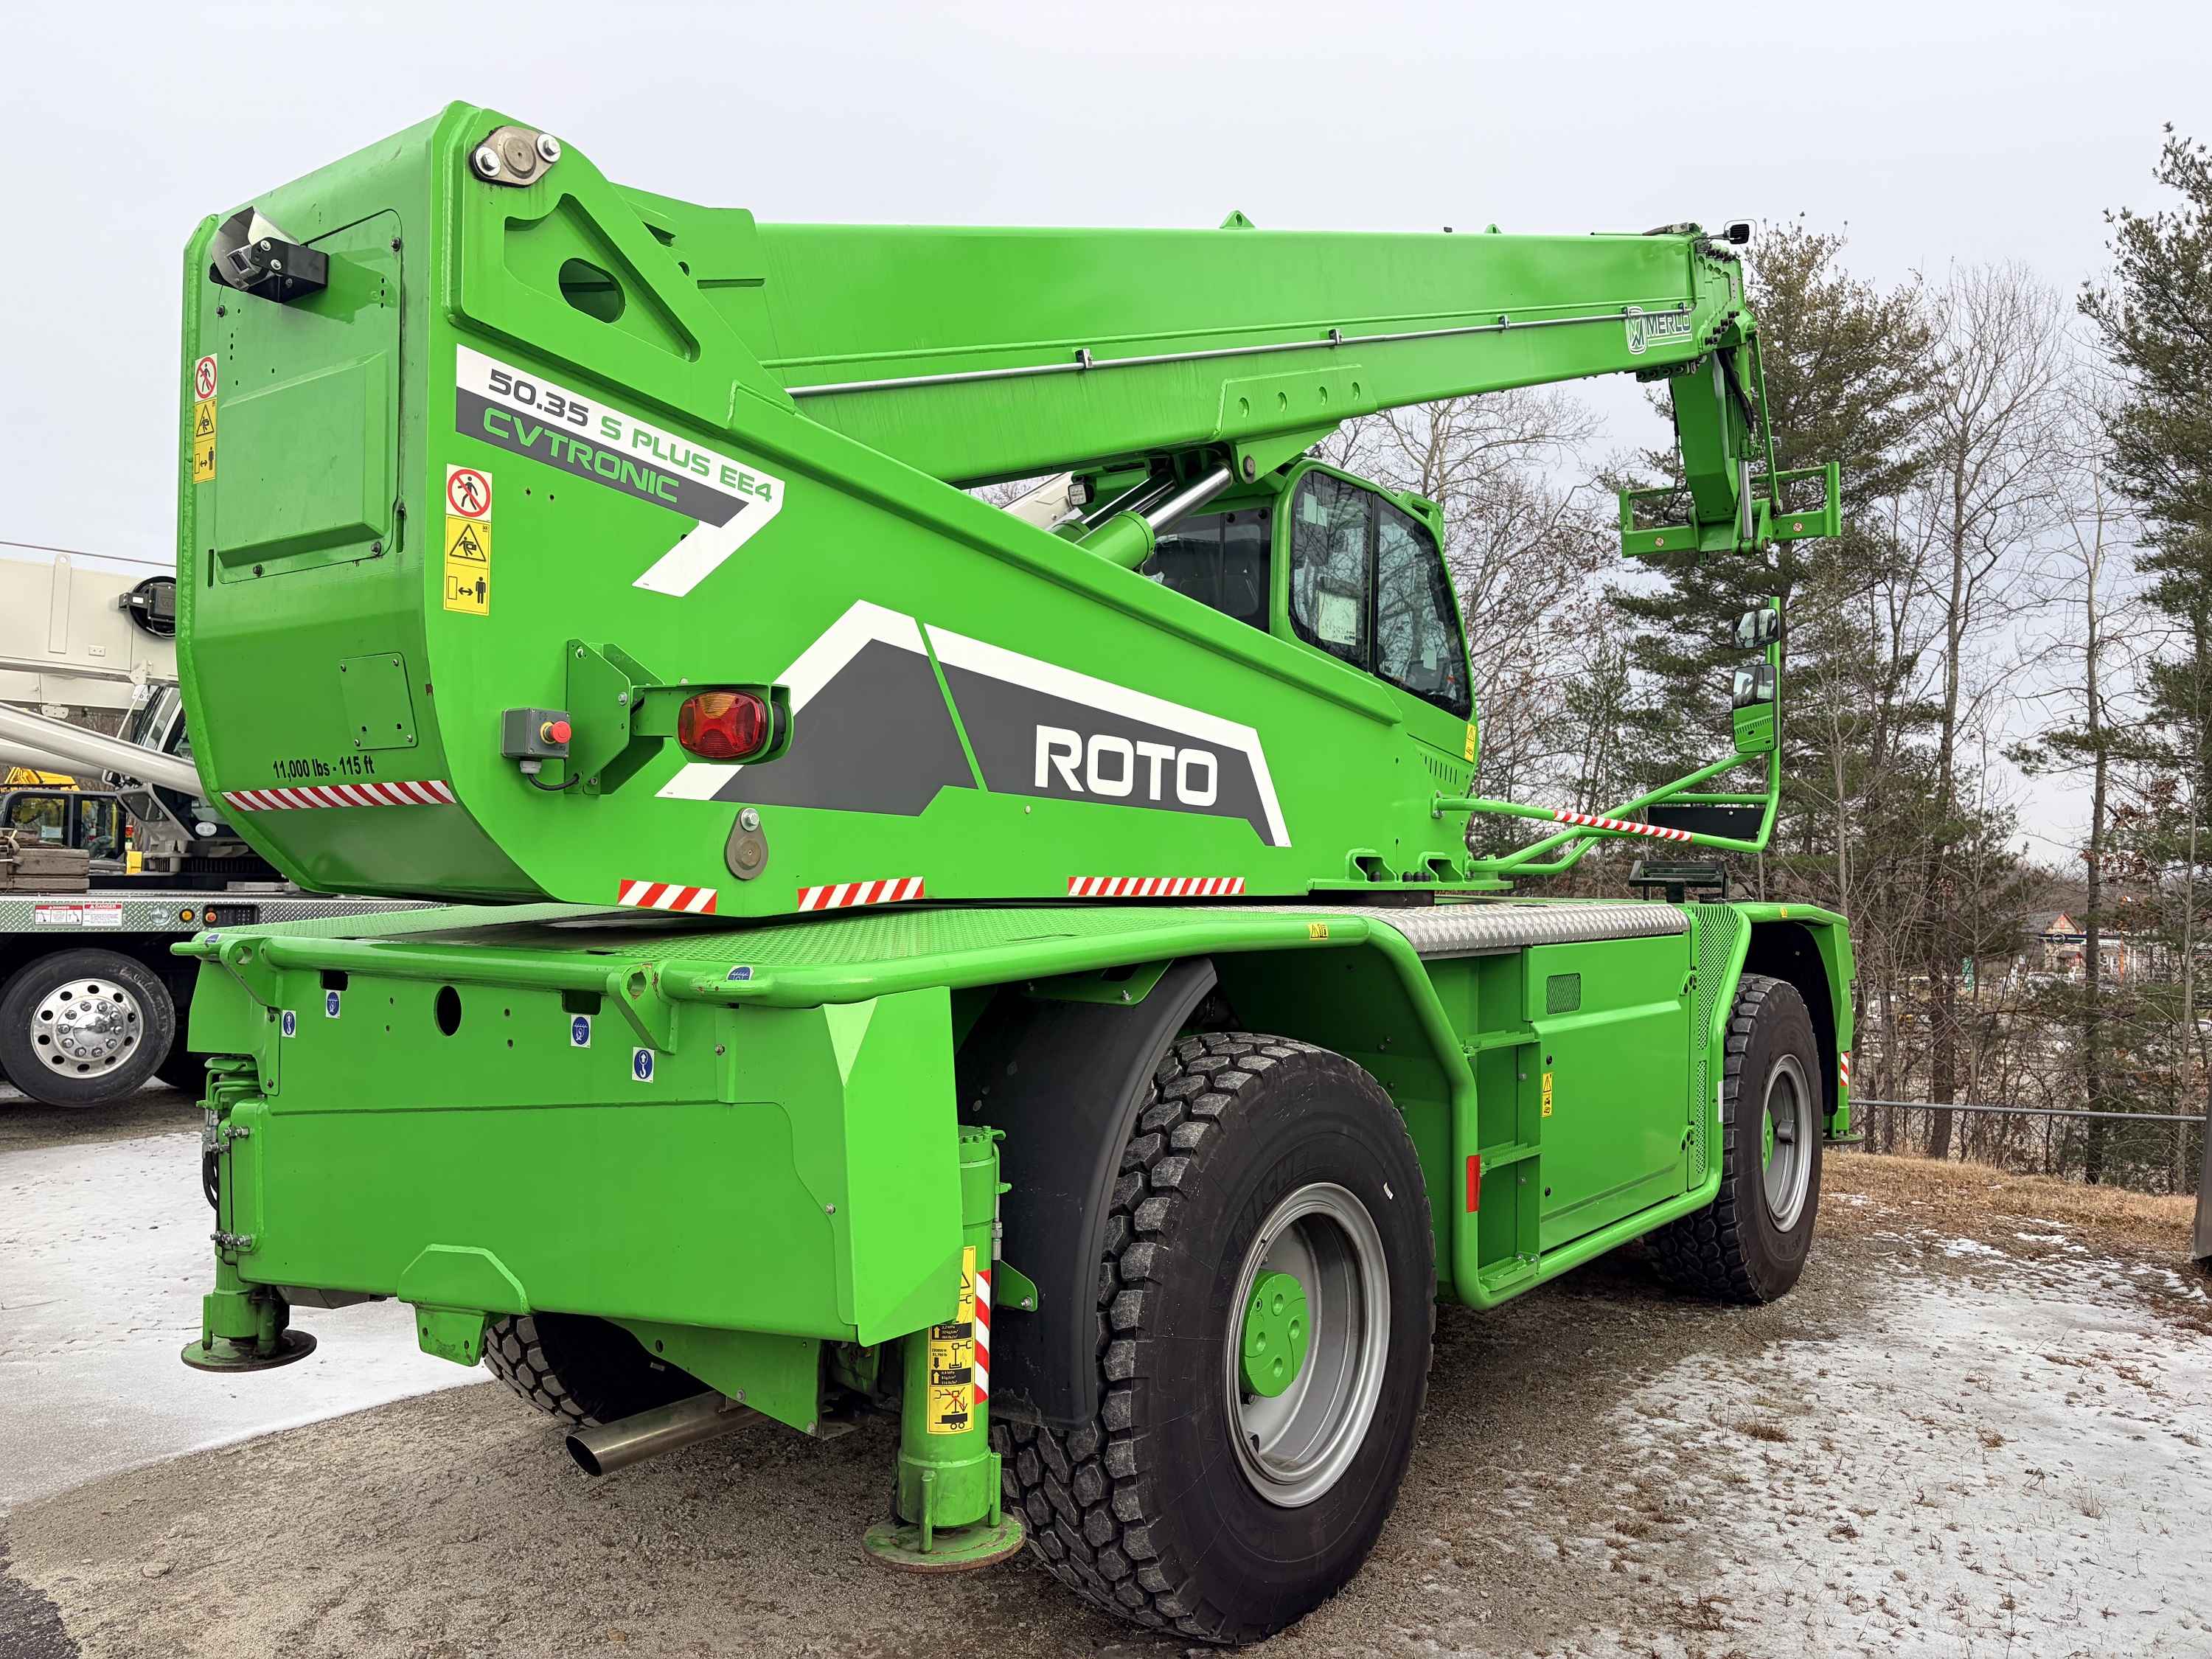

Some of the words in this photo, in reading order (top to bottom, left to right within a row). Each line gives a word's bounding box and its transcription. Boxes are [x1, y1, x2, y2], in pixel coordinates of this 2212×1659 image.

[1645, 312, 1692, 337] MERLO
[483, 407, 680, 504] CVTRONIC
[488, 369, 589, 427] 50.35
[600, 415, 623, 441] S
[632, 428, 712, 477] PLUS
[720, 465, 773, 502] EE4
[273, 759, 310, 782] 11,000
[312, 758, 330, 777] lbs
[340, 756, 361, 775] 115
[364, 755, 375, 774] ft
[1034, 724, 1218, 807] ROTO
